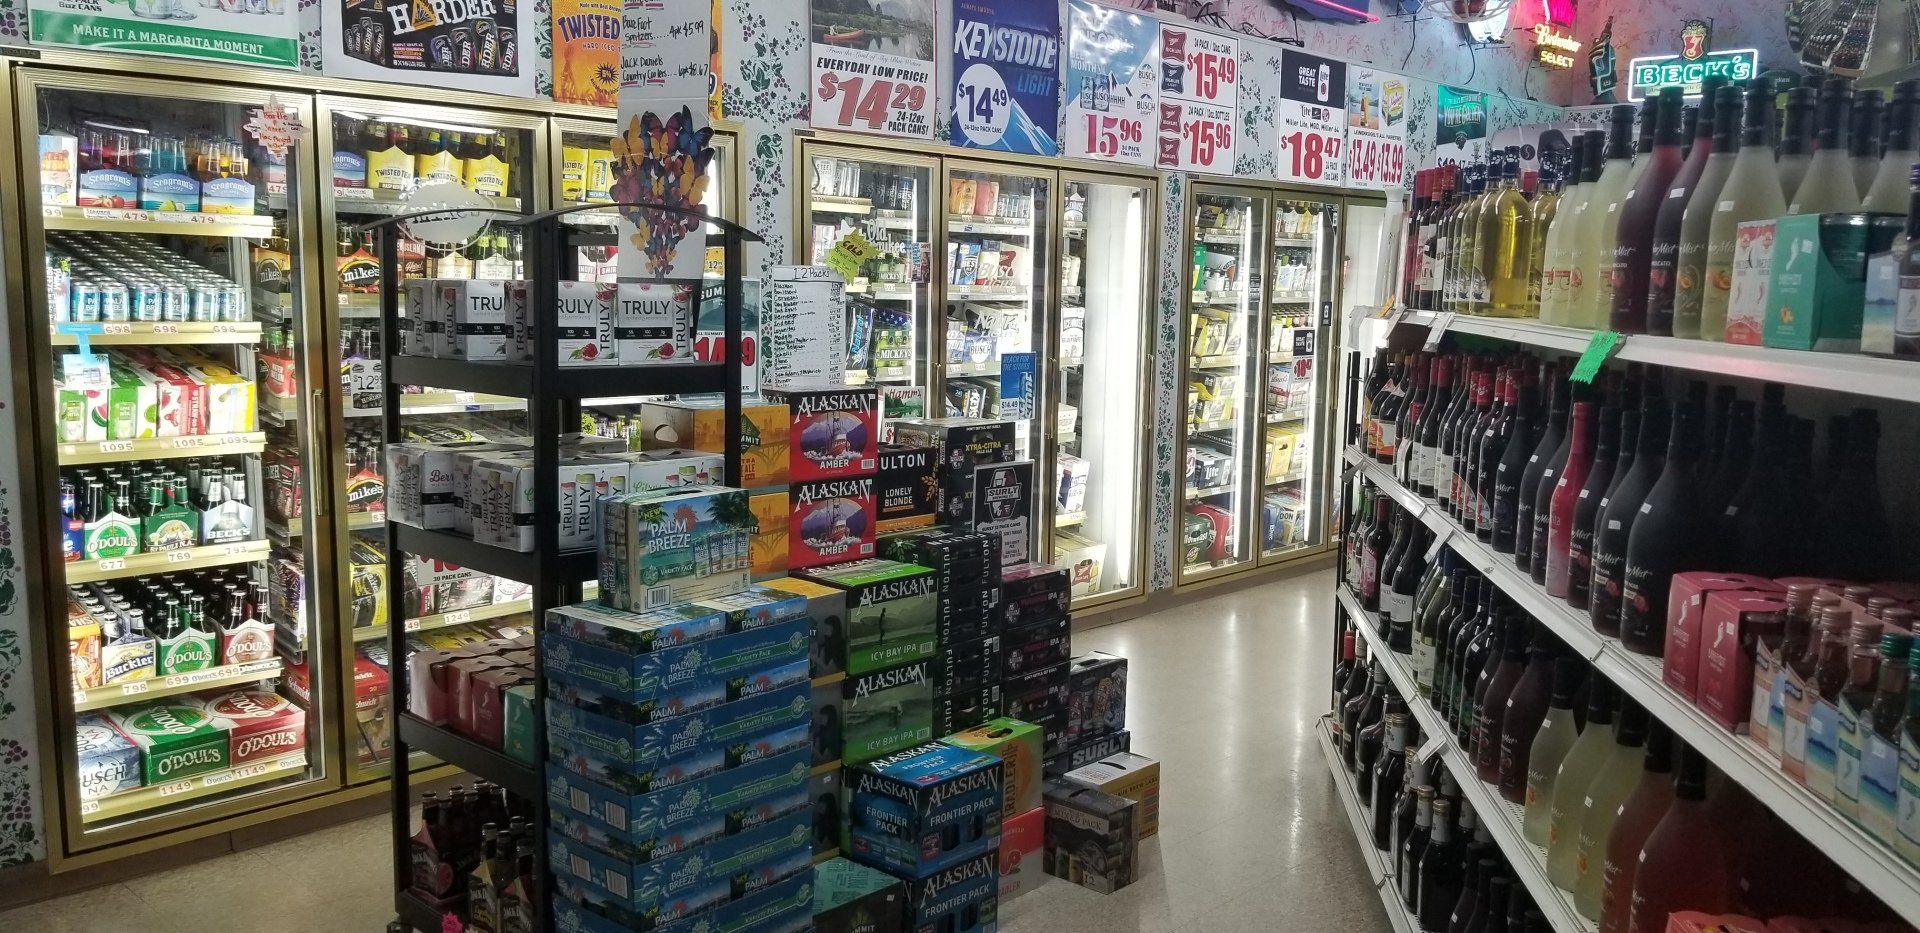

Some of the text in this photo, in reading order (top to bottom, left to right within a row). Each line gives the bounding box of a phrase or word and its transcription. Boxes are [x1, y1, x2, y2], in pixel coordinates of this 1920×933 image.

[79, 4, 102, 12] CANS
[387, 0, 497, 35] HARDER
[558, 14, 620, 42] TWISTED
[73, 24, 264, 55] MAKE IT A MARGARITA MOMENT
[954, 19, 1057, 71] KEYSTONE
[1220, 44, 1231, 55] CANS
[621, 56, 639, 69] Jack
[1540, 50, 1574, 68] SELECT
[817, 57, 928, 83] EVERYDAY LOW PRICE!
[1138, 70, 1156, 82] BUSCH
[1299, 66, 1316, 78] GREAT
[1636, 55, 1751, 87] BECK'S
[622, 71, 646, 86] Country
[1017, 73, 1054, 97] LIGHT
[1299, 76, 1316, 88] TASTE
[1136, 100, 1156, 112] BUSCH
[1300, 104, 1312, 118] Lite
[897, 111, 924, 123] 24-12oz
[1285, 118, 1299, 127] Miller
[888, 122, 928, 135] PACK CANS!
[376, 169, 402, 179] TWISTED
[474, 176, 493, 187] TWISTED
[124, 213, 147, 221] 479
[191, 216, 214, 224] 479
[343, 266, 380, 282] mike's
[793, 267, 830, 280] 12 Packs
[471, 296, 504, 311] TRU
[621, 300, 670, 316] TRULY
[106, 325, 130, 334] 698
[154, 325, 178, 334] 698
[214, 325, 236, 333] 698
[516, 301, 527, 354] TRULY
[600, 302, 611, 352] TRULY
[676, 302, 687, 350] TRULY
[970, 345, 992, 356] BUSCH
[793, 392, 876, 425] ALASKAN
[102, 442, 133, 452] 1095
[175, 439, 203, 448] 1095
[221, 435, 249, 444] 1095
[965, 441, 1001, 452] XTRA-CITRA
[820, 458, 850, 470] AMBER
[880, 454, 926, 470] ULTON
[1205, 465, 1220, 480] Lite
[348, 482, 383, 502] mike's
[793, 479, 872, 512] ALASKAN
[885, 488, 912, 497] LONELY
[988, 486, 1019, 498] SURLY
[884, 497, 913, 507] BLONDE
[563, 492, 574, 532] TRULY
[578, 486, 591, 535] TRULY
[207, 527, 250, 539] BECK'S
[651, 518, 688, 536] PALM
[87, 536, 138, 554] O'DOUL'S
[226, 547, 247, 555] 793
[648, 534, 691, 553] BREEZE
[819, 544, 849, 557] AMBER
[101, 560, 123, 569] 677
[169, 552, 191, 561] 769
[981, 540, 990, 584] FULTON
[942, 546, 950, 593] FULTON
[856, 576, 933, 617] ALASKAN
[446, 612, 468, 623] 1249
[981, 590, 989, 636] FULTON
[741, 617, 765, 630] PALM
[942, 599, 951, 645] FULTON
[227, 642, 272, 657] O'DOUL'S
[652, 637, 677, 651] PALM
[165, 650, 212, 667] O'DOUL'S
[871, 643, 917, 662] ICY BAY IPA
[106, 655, 153, 679] Buckler
[167, 668, 239, 686] 699 699
[668, 669, 697, 684] BREEZE
[852, 661, 928, 708] ALASKAN
[124, 684, 147, 693] 798
[651, 706, 676, 721] PALM
[237, 731, 297, 758] O'DOUL'S
[670, 738, 697, 753] BREEZE
[867, 731, 914, 751] ICY BAY IPA
[869, 741, 951, 773] ALASKAN
[1072, 735, 1129, 767] SURLY
[158, 748, 221, 775] O'DOUL'S
[161, 765, 266, 795] 1149 1149
[857, 773, 919, 811] ALASKAN
[924, 765, 1001, 818] ALASKAN
[866, 806, 908, 827] FRONTIER
[930, 796, 995, 826] FRONTIER PACK
[876, 819, 898, 835] PACK
[920, 853, 996, 910] ALASKAN
[925, 884, 990, 918] FRONTIER PACK
